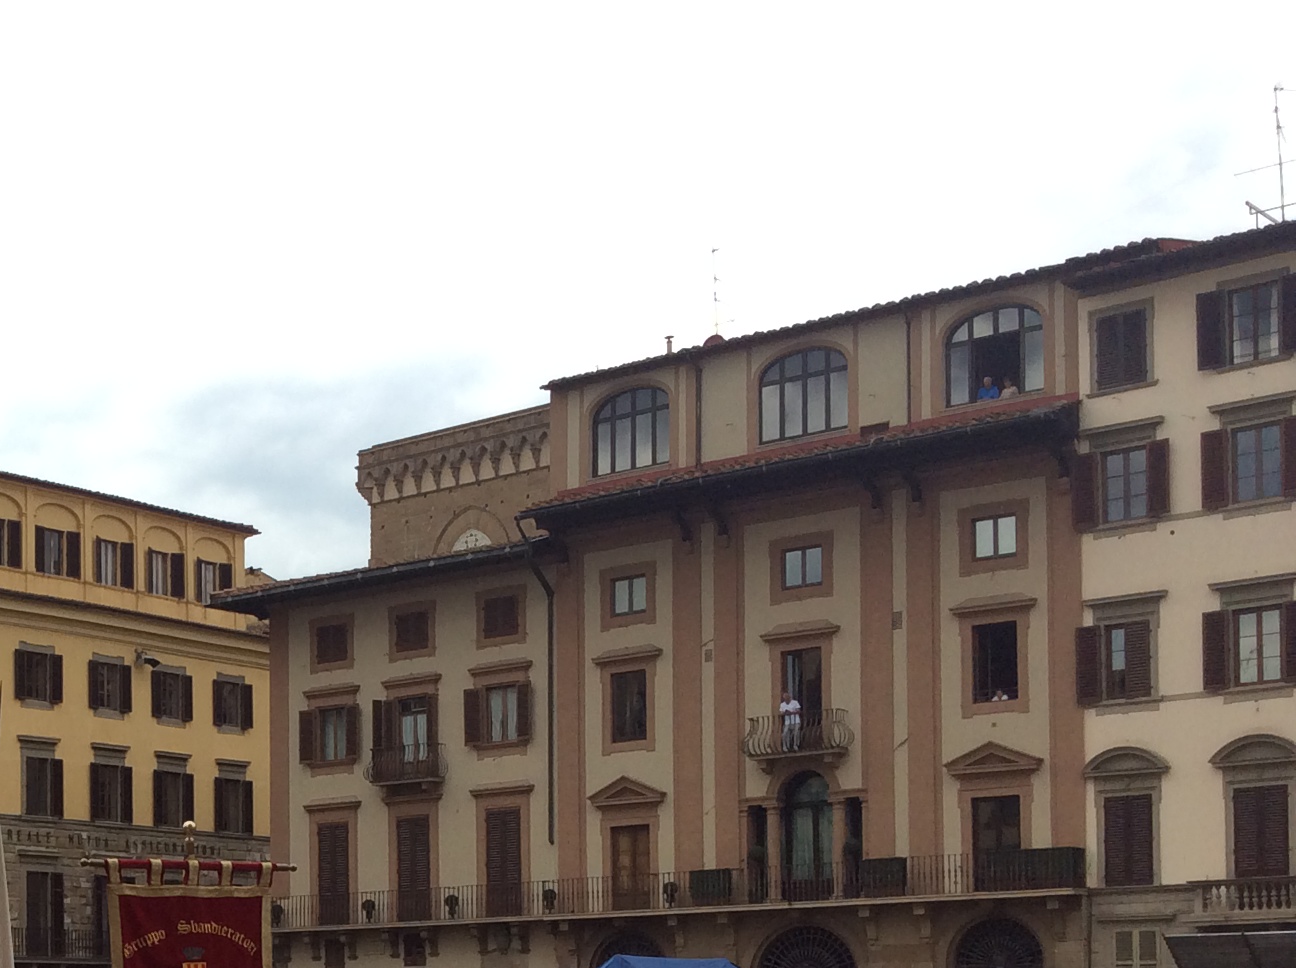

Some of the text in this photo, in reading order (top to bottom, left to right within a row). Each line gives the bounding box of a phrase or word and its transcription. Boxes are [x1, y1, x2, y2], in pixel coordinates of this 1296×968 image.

[7, 828, 52, 843] REALE
[125, 838, 221, 857] ASSICURAIONI
[124, 920, 257, 959] Gruppo Sbandieratori
